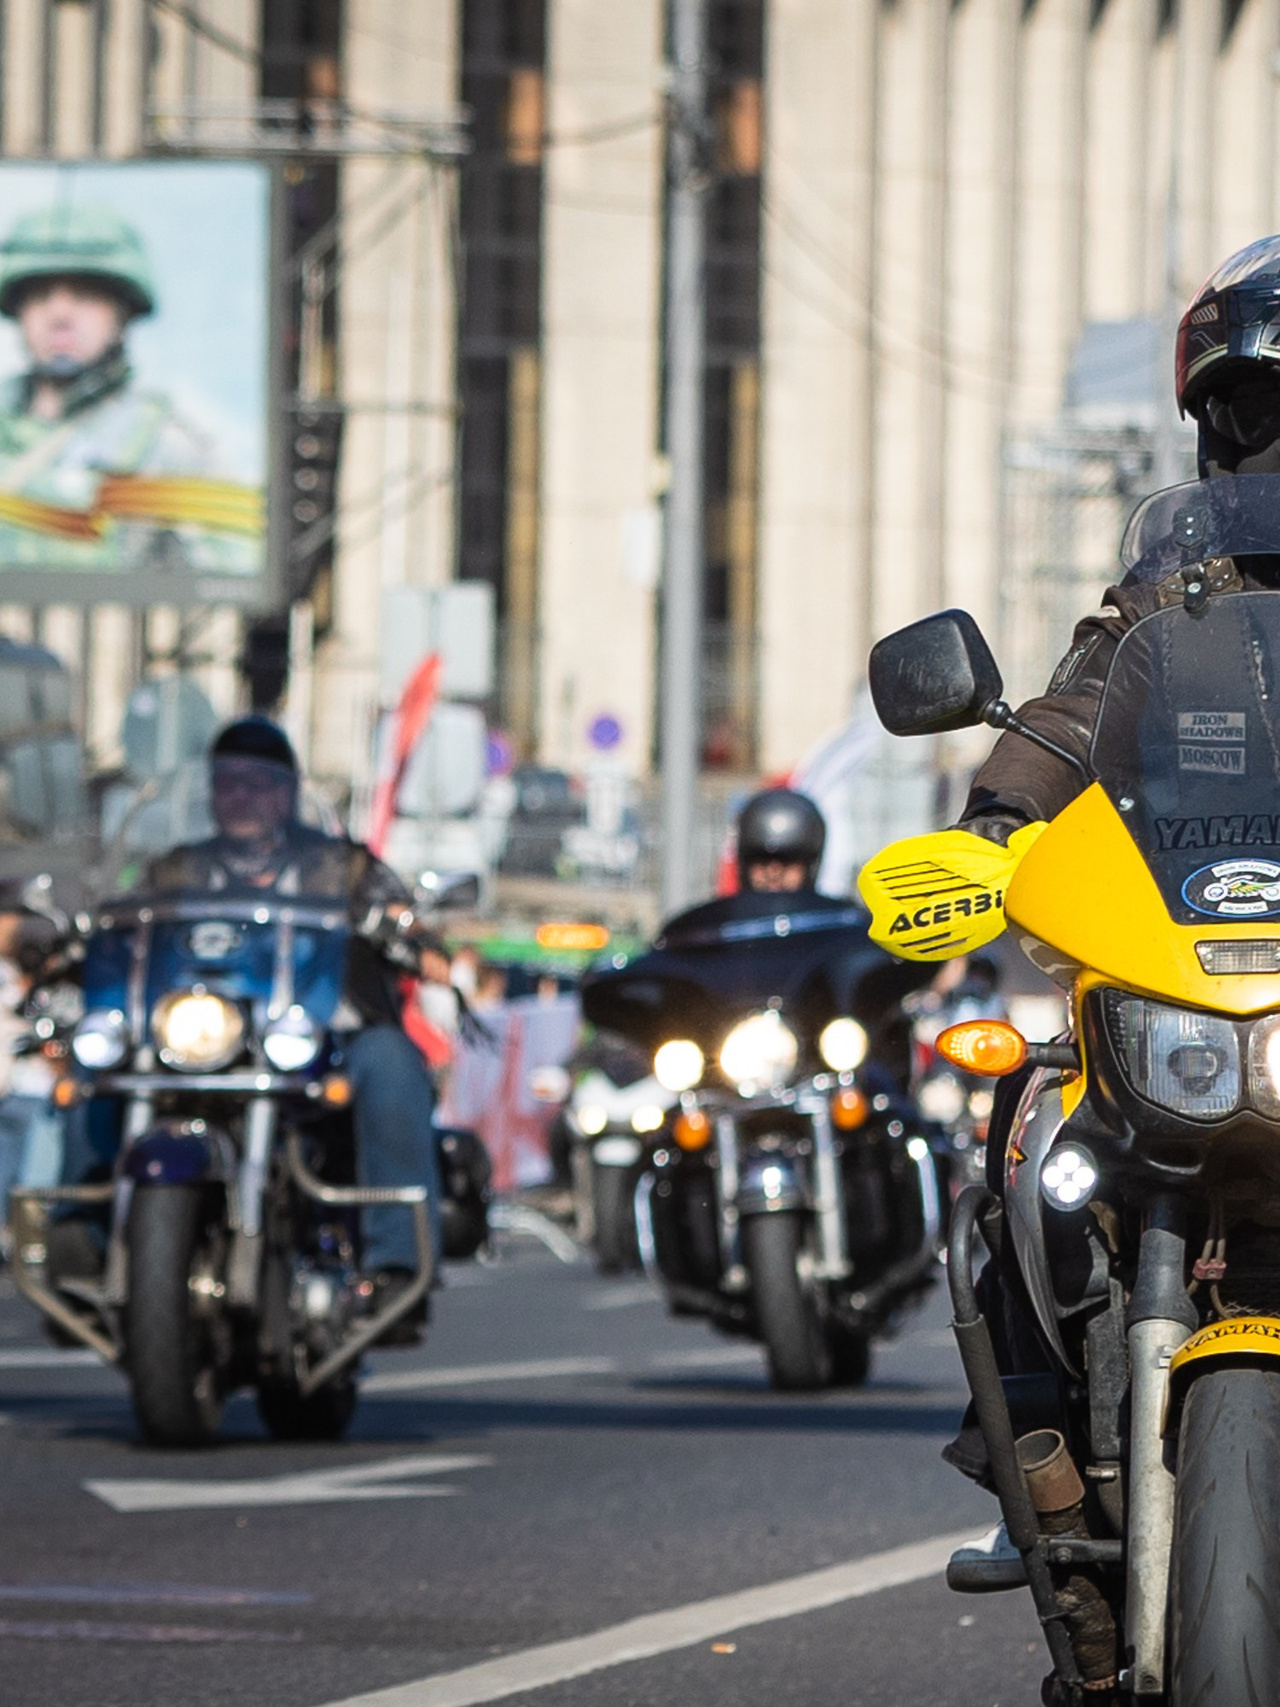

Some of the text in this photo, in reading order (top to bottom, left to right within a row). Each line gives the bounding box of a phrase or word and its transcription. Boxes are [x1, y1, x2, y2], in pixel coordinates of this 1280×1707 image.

[1192, 714, 1228, 725] IRON
[1180, 727, 1244, 738] SHADOWS
[1181, 747, 1242, 771] MOSCOW
